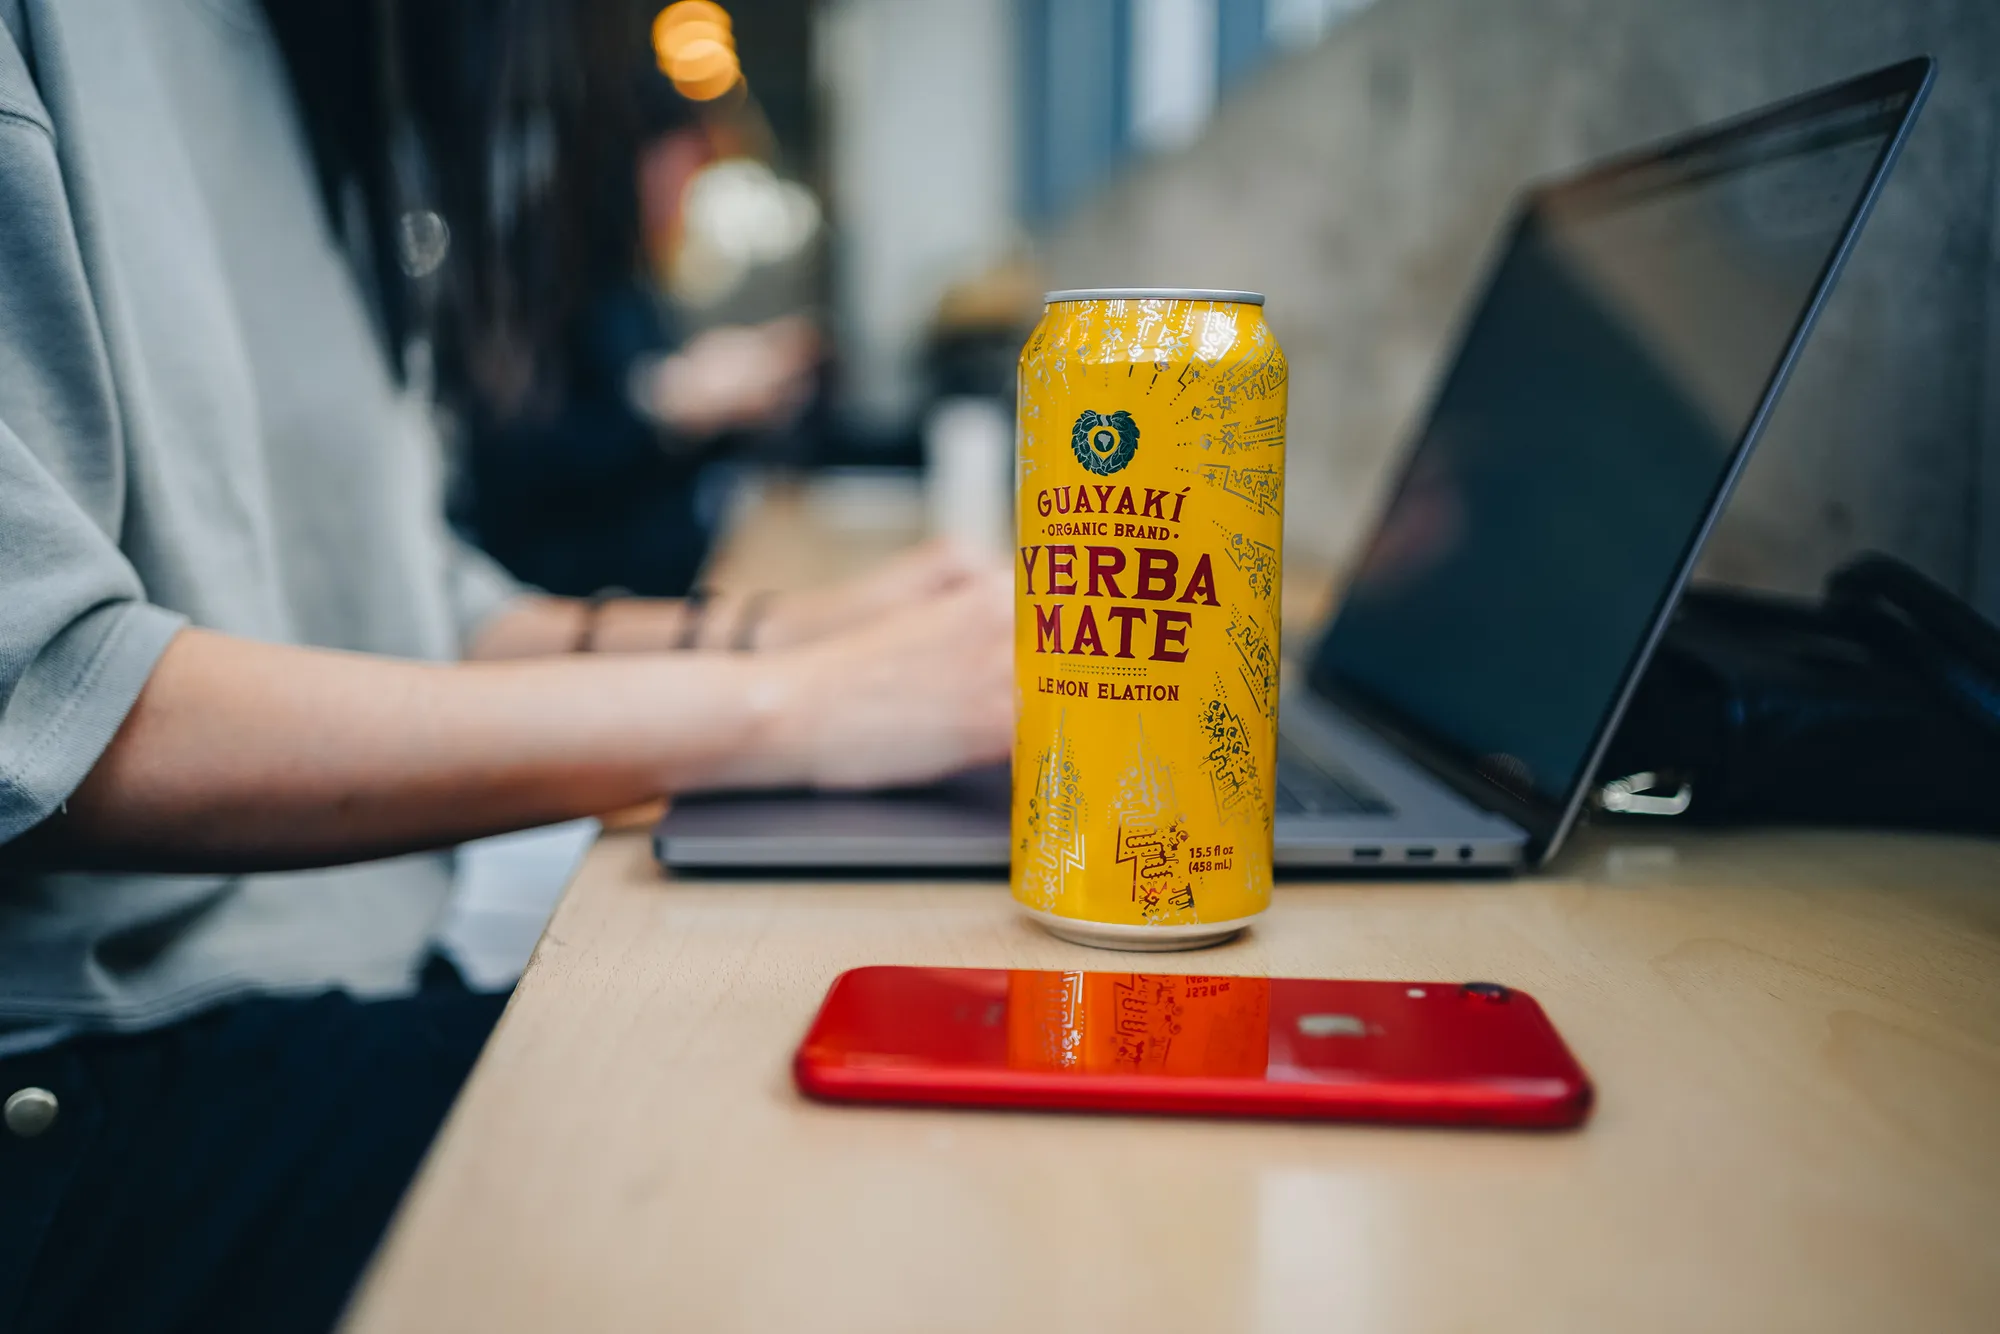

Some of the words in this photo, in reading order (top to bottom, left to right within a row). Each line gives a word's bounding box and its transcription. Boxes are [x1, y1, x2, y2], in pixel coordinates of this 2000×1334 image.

[1037, 485, 1191, 523] GUAYAKÍ
[1047, 522, 1108, 537] ORGANIC
[1113, 523, 1170, 541] BRAND
[1020, 544, 1221, 607] YERBA
[1033, 604, 1193, 663] MATE
[1038, 676, 1089, 698] LEMON
[1097, 682, 1180, 702] ELATION
[1189, 846, 1212, 859] 15.5
[1214, 844, 1221, 857] fl
[1222, 846, 1234, 856] oz
[1188, 861, 1212, 875] (458
[1214, 858, 1232, 871] mL)
